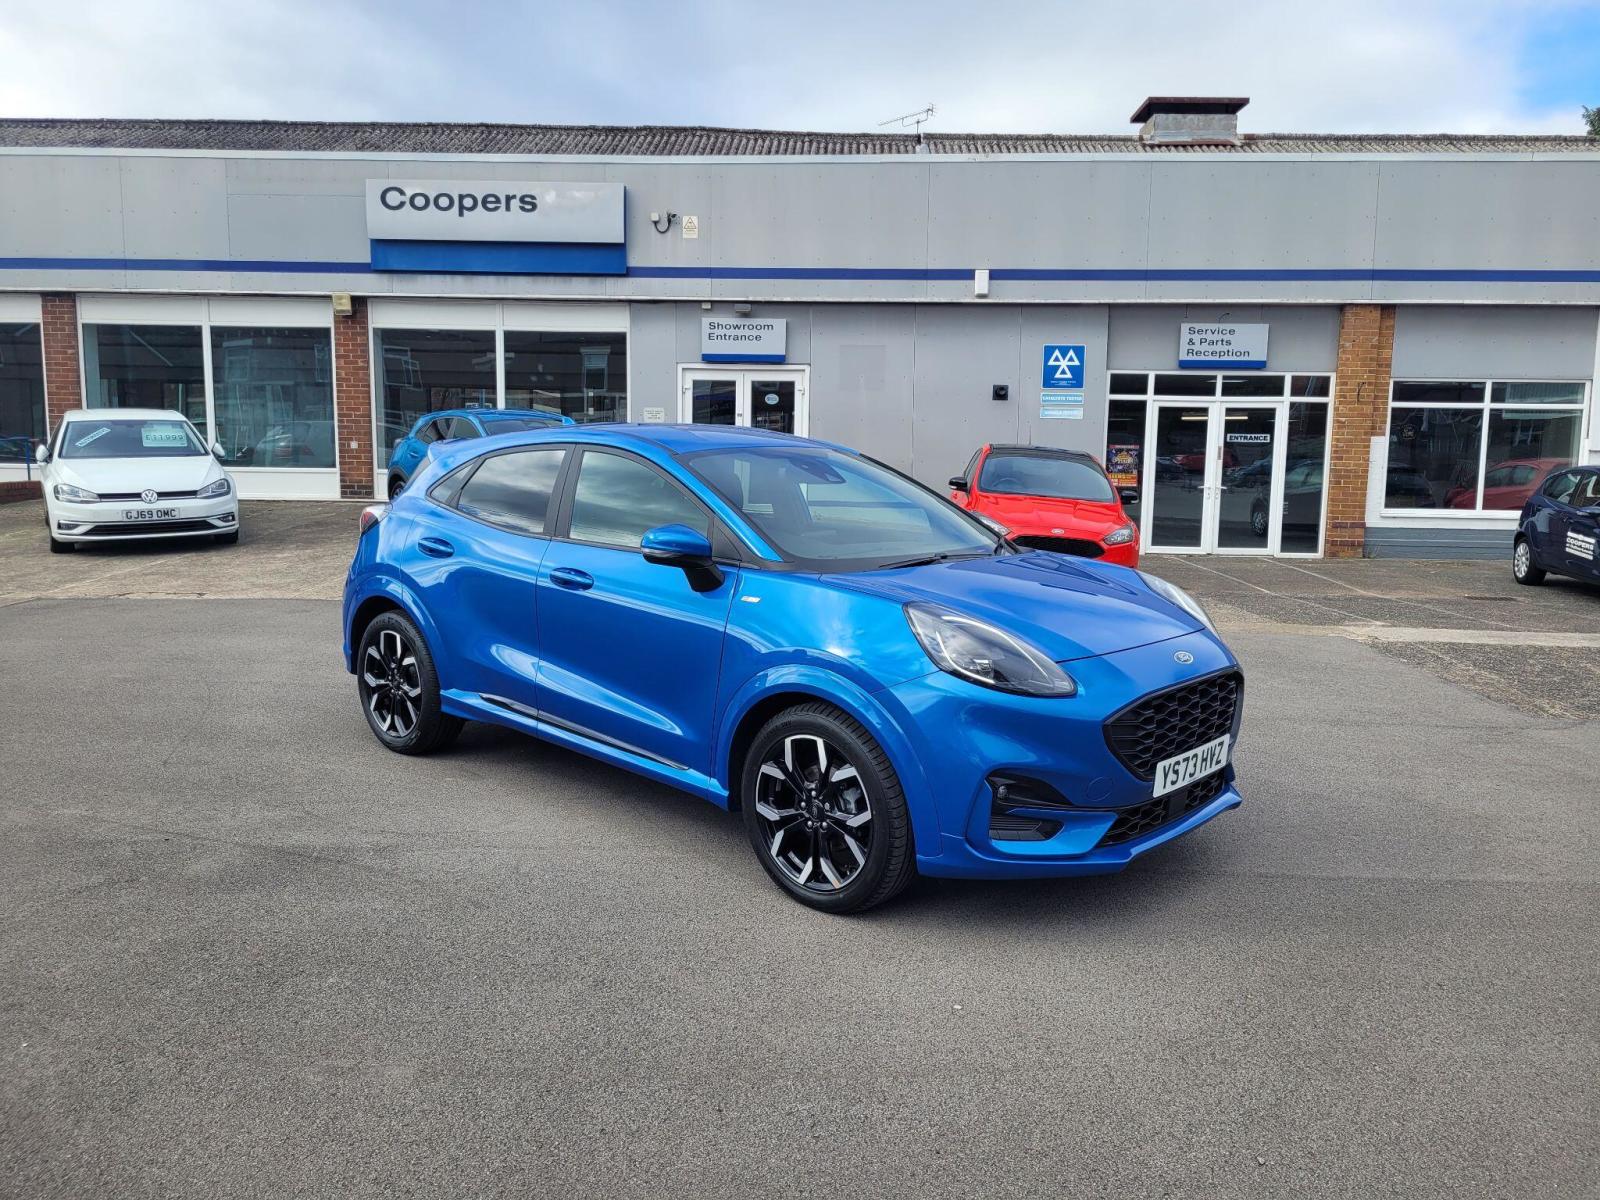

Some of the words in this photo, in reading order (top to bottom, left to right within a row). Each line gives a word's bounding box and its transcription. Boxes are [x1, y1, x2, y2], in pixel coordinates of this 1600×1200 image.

[380, 186, 538, 217] Coopers
[708, 321, 774, 331] Showroom
[1188, 326, 1236, 336] Service
[708, 332, 762, 341] Entrance
[1187, 337, 1196, 346] &
[1199, 337, 1232, 346] Parts
[1186, 348, 1250, 358] Reception
[125, 510, 154, 520] GJ69
[156, 508, 177, 519] OMC
[1566, 537, 1594, 551] COOPERS
[1162, 752, 1199, 790] YS73
[1199, 740, 1225, 774] HVZ
